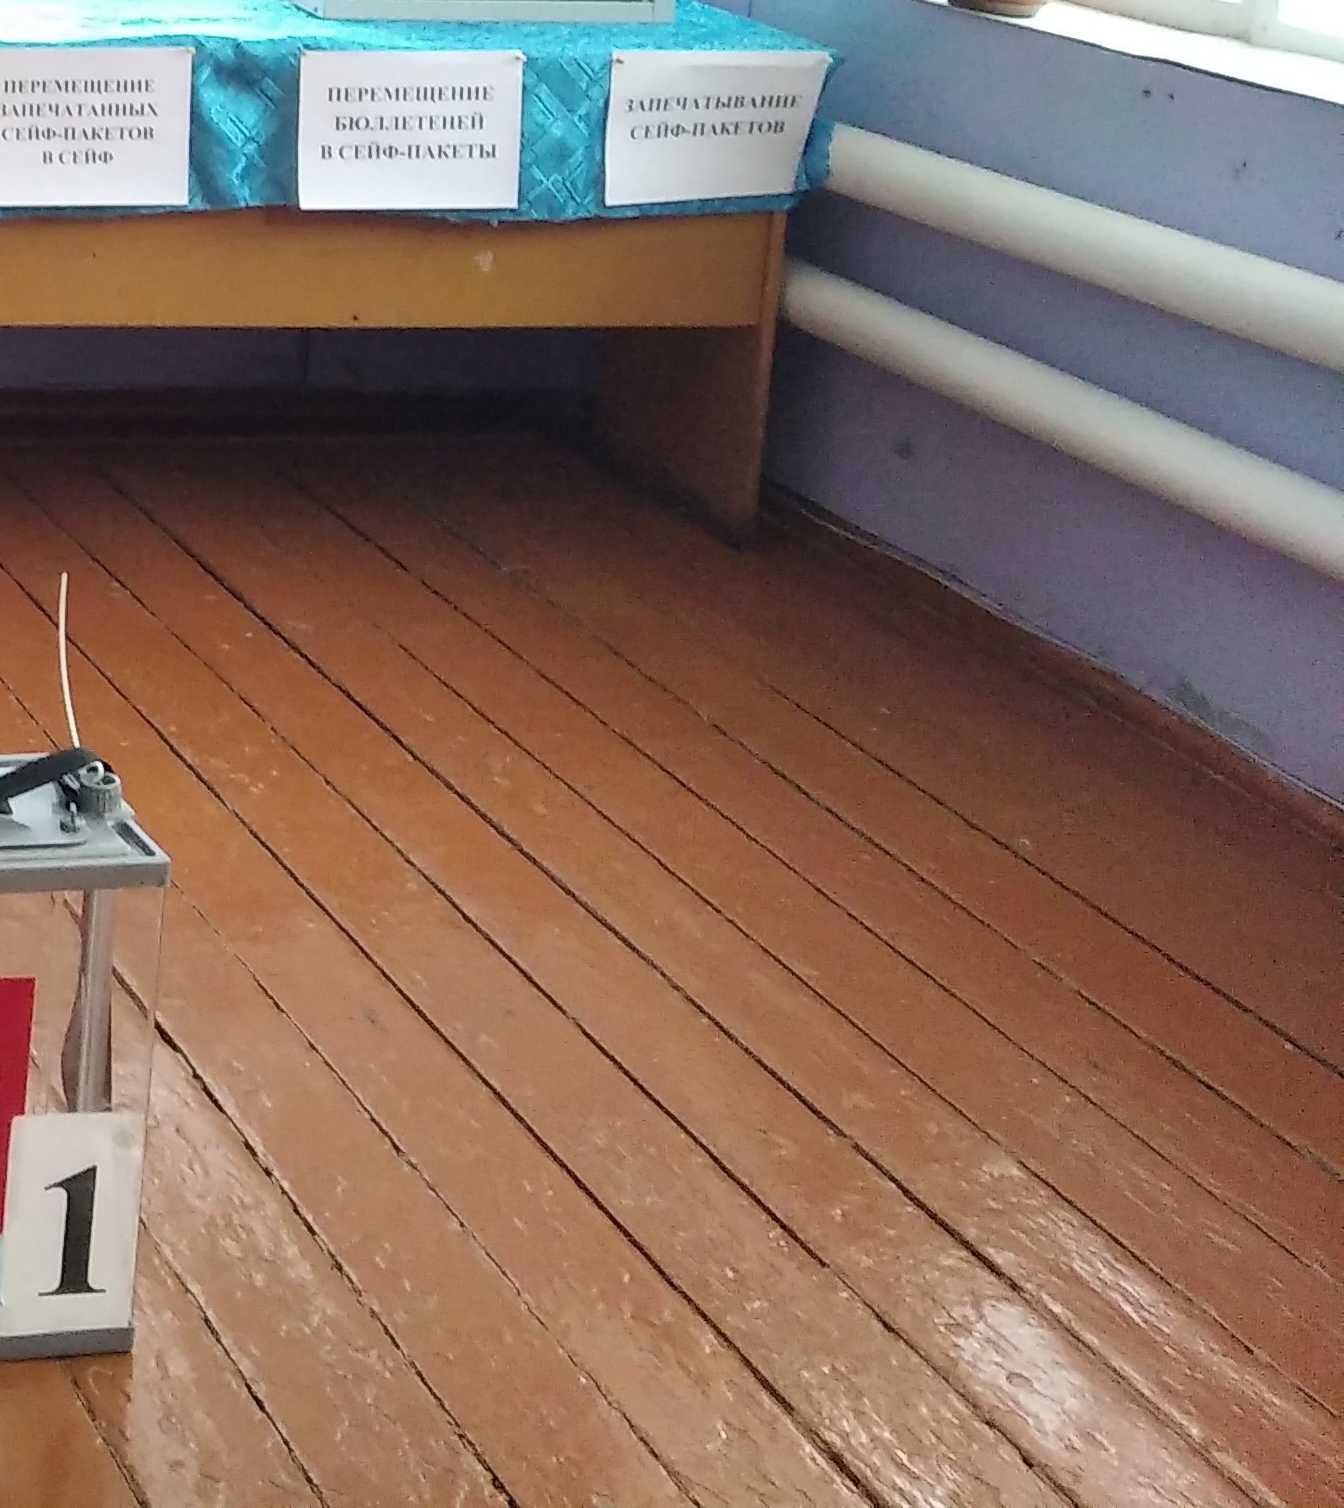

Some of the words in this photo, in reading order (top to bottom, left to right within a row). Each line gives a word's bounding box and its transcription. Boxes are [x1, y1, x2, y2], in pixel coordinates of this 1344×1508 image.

[3, 79, 156, 95] ПЕРЕМЕЩЕНИЕ
[327, 86, 495, 103] ПЕРЕМЕЩЕНИЕ
[0, 102, 159, 117] ЗАПЕЧАТАННЫХ
[625, 95, 803, 113] ЗАПЕЧАТЫВАНИЕ
[334, 111, 485, 131] БЮЛЛЕТЕНЕЙ
[1, 125, 155, 141] СЕЙФ-ПАКЕТОВ
[630, 120, 787, 140] СЕЙФ-ПАКЕТОВ
[41, 150, 54, 165] В
[58, 148, 114, 165] СЕЙФ
[320, 144, 333, 160] В
[338, 142, 498, 160] СЕЙФ-ПАКЕТЫ
[37, 1164, 108, 1297] 1
